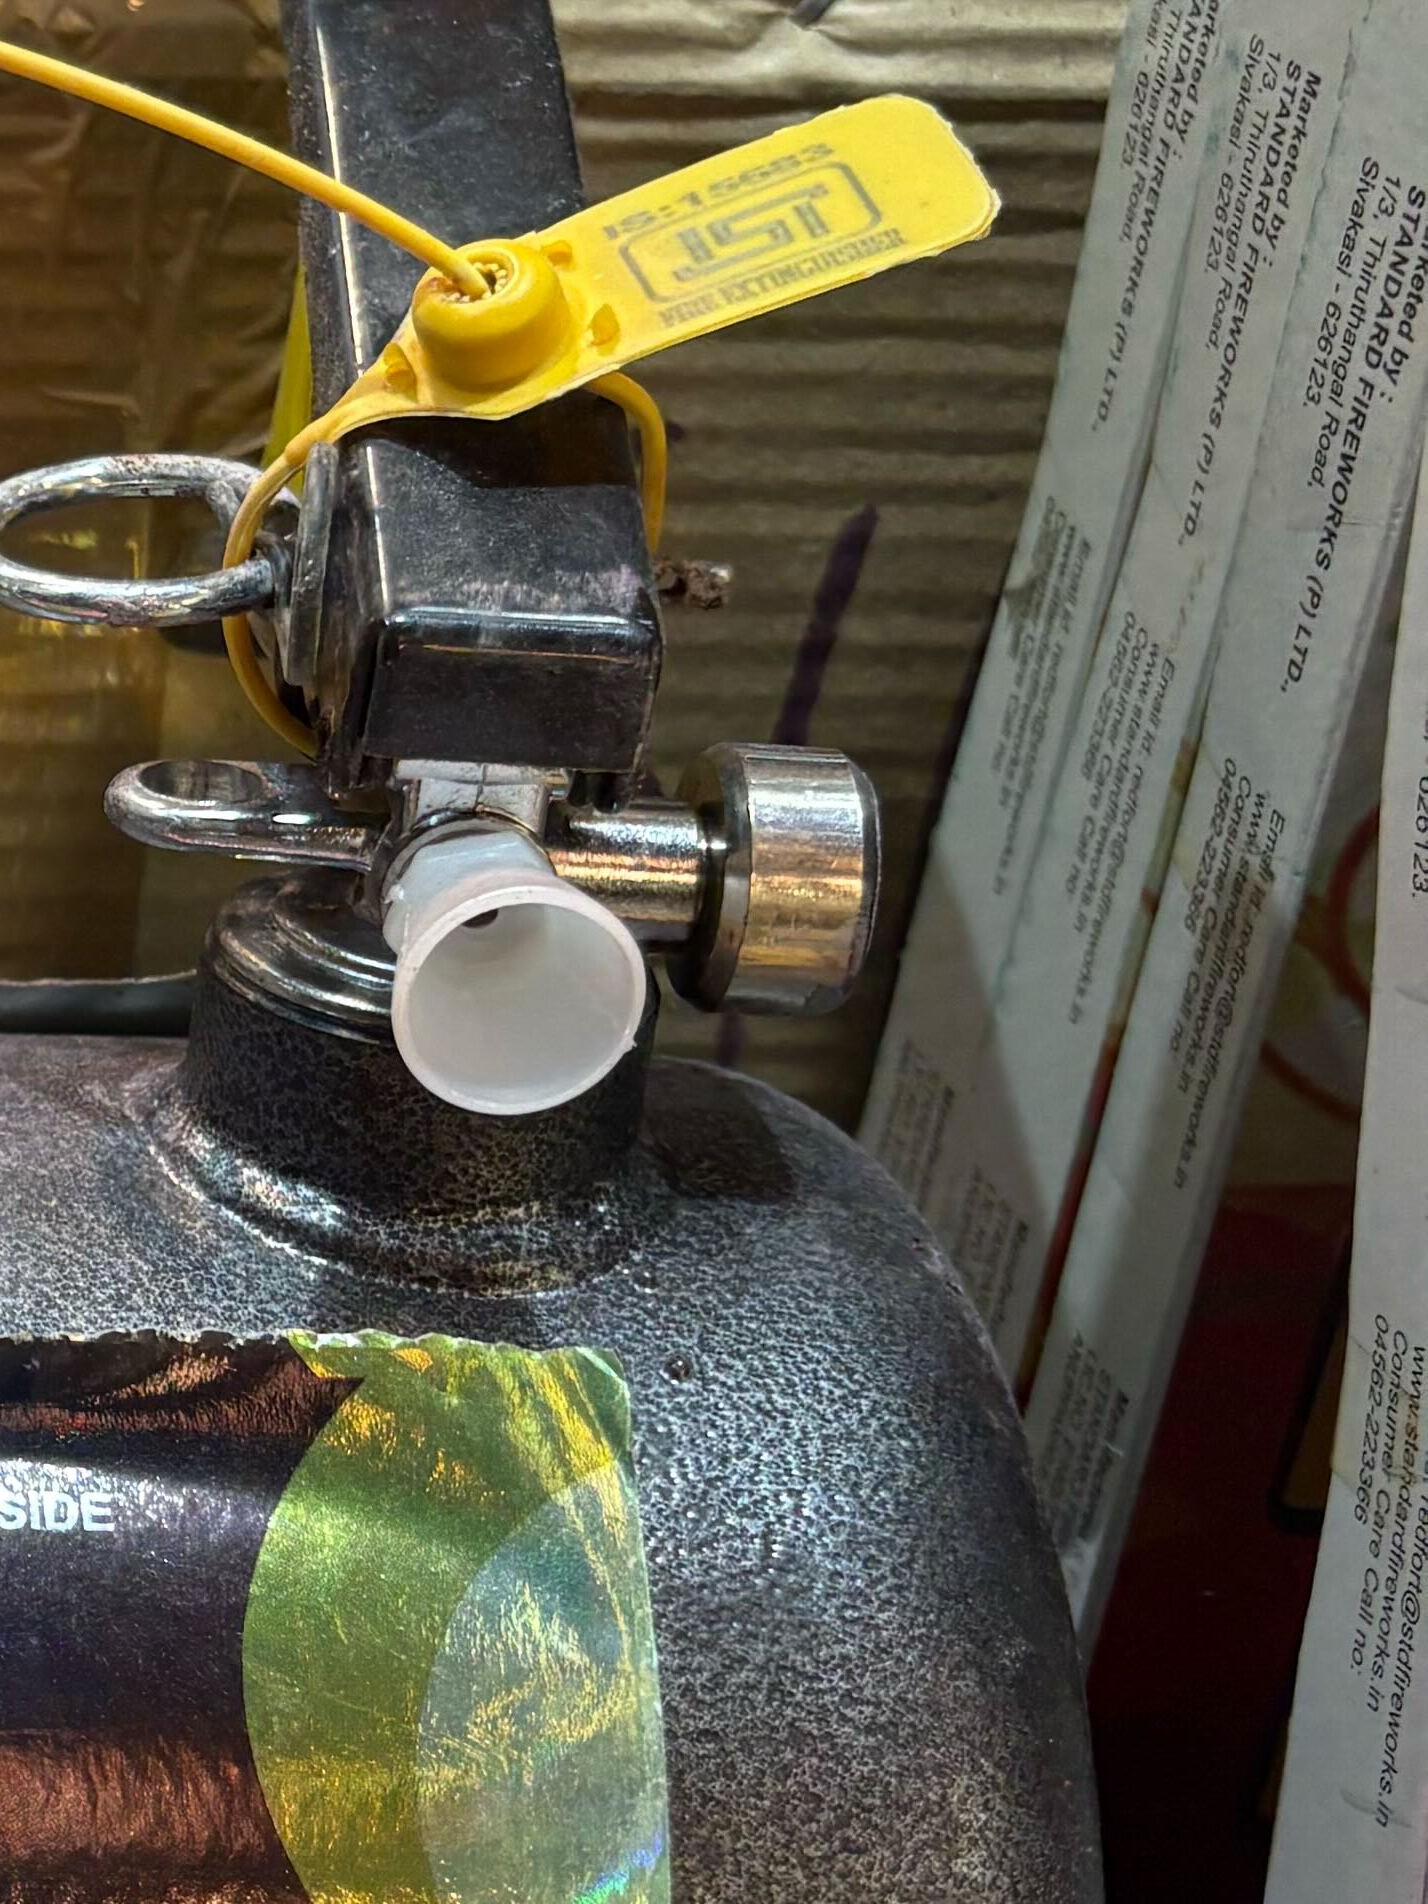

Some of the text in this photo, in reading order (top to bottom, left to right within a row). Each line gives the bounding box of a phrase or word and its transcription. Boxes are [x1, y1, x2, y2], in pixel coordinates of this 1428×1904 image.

[1174, 107, 1194, 140] by
[1249, 59, 1301, 233] STANDARD
[1263, 69, 1321, 252] Marketed by
[1207, 241, 1261, 427] FIREWORKS
[1302, 155, 1380, 410] Sivakasi 626123.
[1306, 171, 1401, 491] 1/3, Thiruthangal Road,
[1364, 183, 1425, 370] STANDARD
[1380, 344, 1407, 387] by
[1313, 376, 1376, 571] FIREWORKS
[1297, 574, 1325, 620] (P)
[1209, 774, 1253, 900] Consumer
[1193, 904, 1219, 964] Care
[1351, 1313, 1393, 1526] 04562-223366
[1376, 1328, 1409, 1476] Consumer
[1358, 1566, 1380, 1624] Call
[1366, 1346, 1428, 1712] www.standardfireworks.in
[1367, 1488, 1390, 1559] Care
